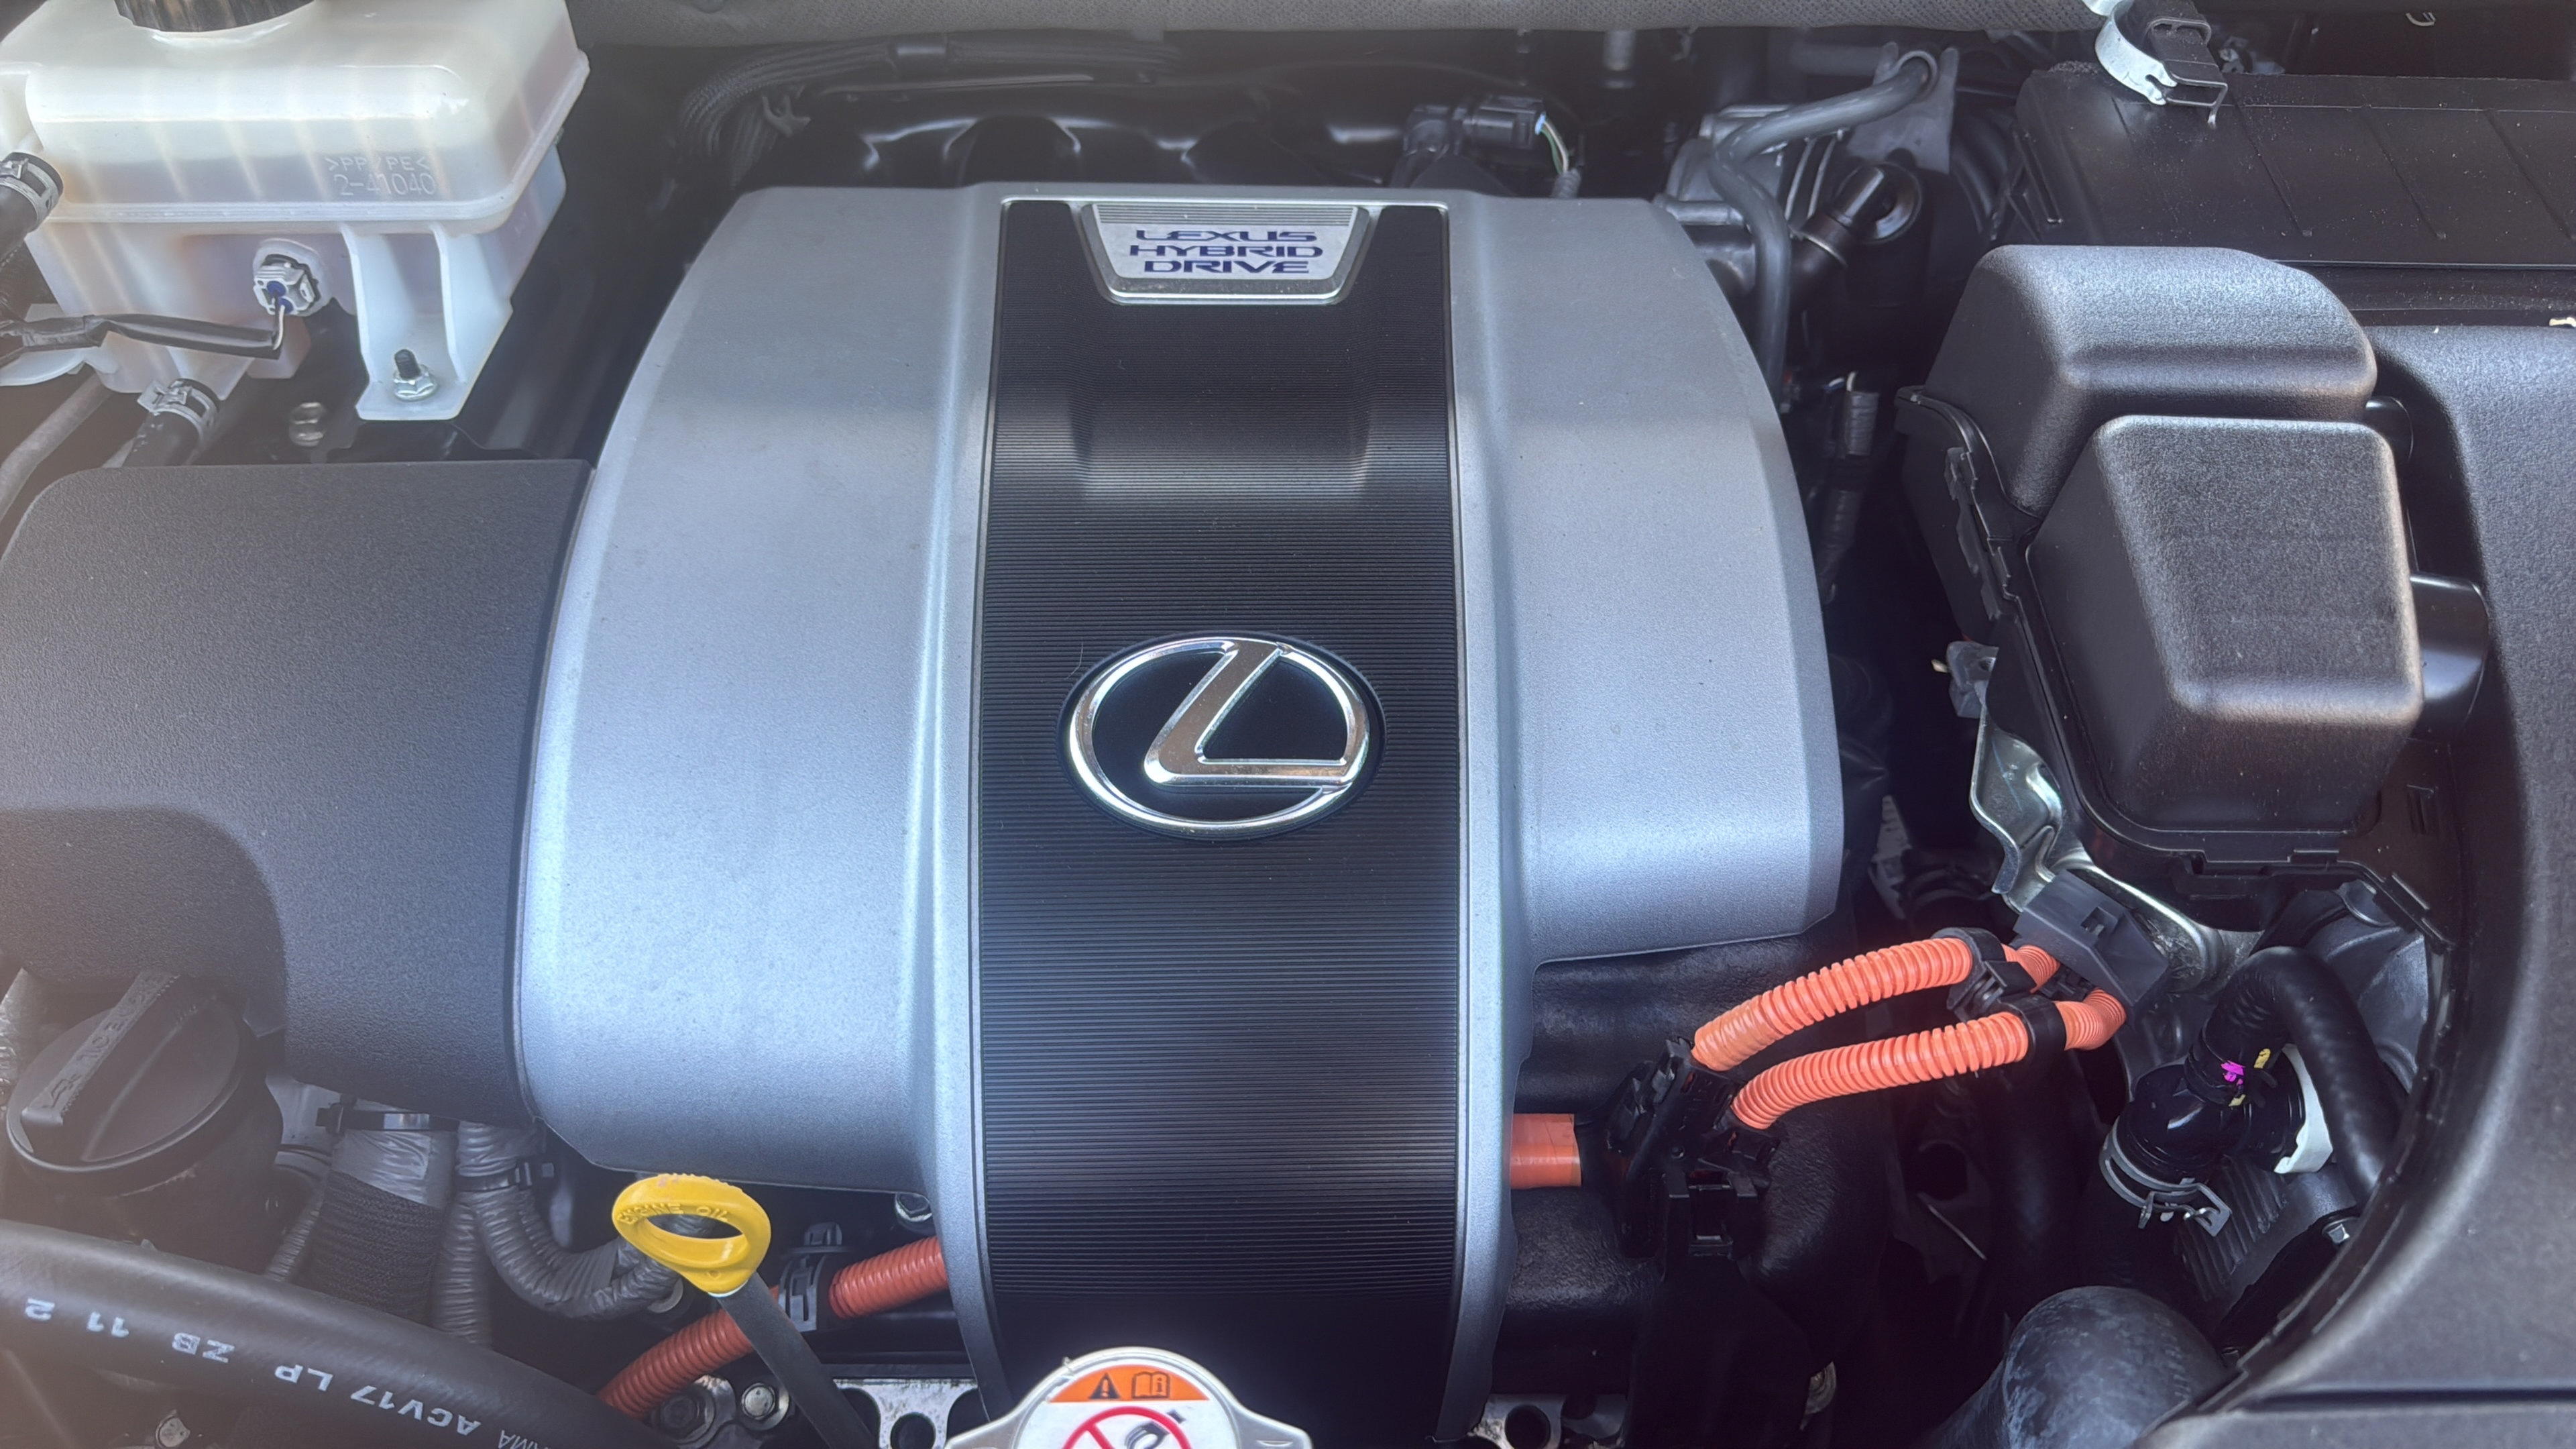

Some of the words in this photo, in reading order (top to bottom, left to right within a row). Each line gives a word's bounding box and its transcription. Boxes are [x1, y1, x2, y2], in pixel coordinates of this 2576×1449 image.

[1135, 229, 1319, 242] LEXUS
[1129, 244, 1324, 258] HYBRID
[1143, 260, 1310, 274] DRIVE
[616, 1203, 684, 1226] ENGINE
[695, 1205, 729, 1222] OIL
[25, 1297, 55, 1321] 2
[86, 1311, 129, 1338] 11
[172, 1332, 235, 1363] ZB
[274, 1364, 333, 1392] LP
[349, 1385, 482, 1436] ACV17
